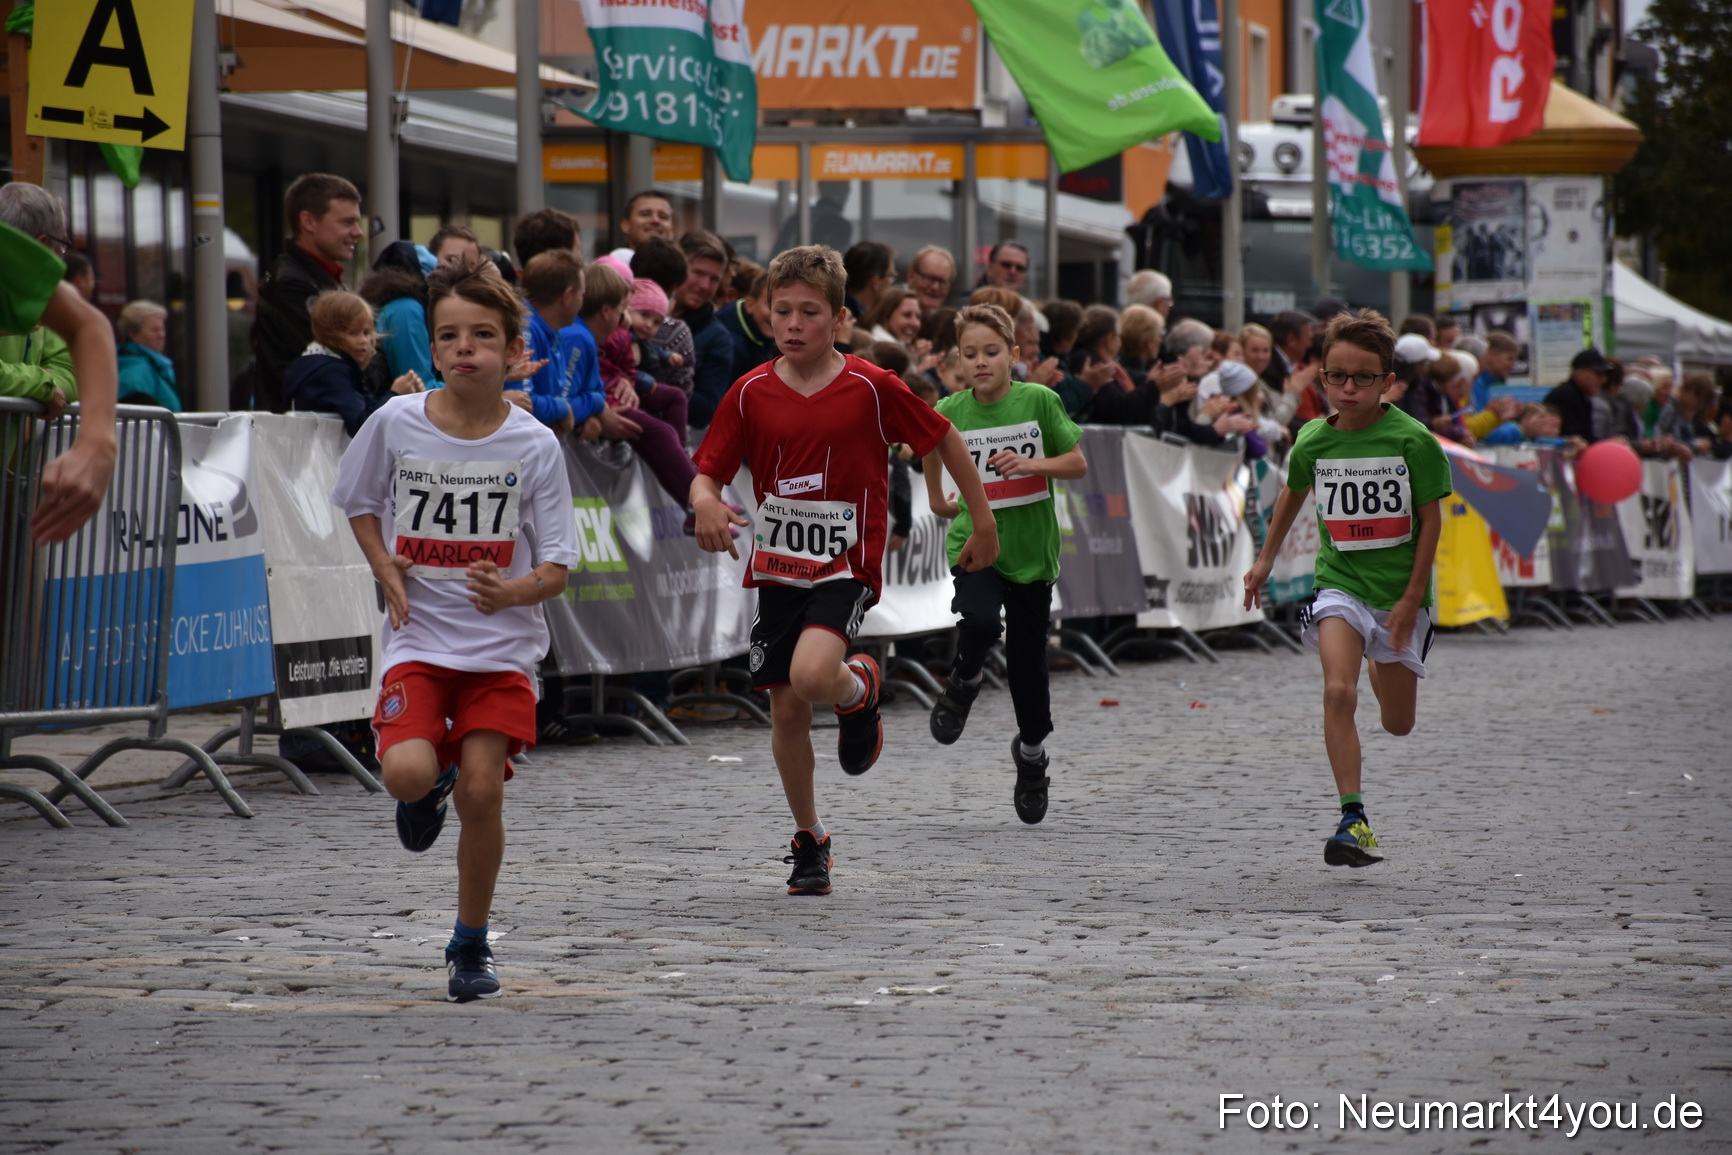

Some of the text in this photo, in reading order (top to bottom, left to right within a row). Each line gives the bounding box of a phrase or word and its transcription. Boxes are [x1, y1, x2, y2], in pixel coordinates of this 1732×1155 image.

[63, 0, 155, 97] A
[823, 152, 952, 174] RUNMARKT.DE
[986, 431, 1027, 445] Neumarkt
[970, 442, 1036, 477] 742
[400, 469, 501, 485] PARTL Neumarkt
[1316, 467, 1392, 478] PARTL Neumarkt
[789, 480, 810, 491] DEHN
[1324, 479, 1403, 516] 7083
[409, 488, 509, 535] 7417
[790, 508, 839, 521] Neumarkt
[765, 516, 848, 559] 7005
[1348, 524, 1374, 538] Tim
[400, 539, 501, 566] MARLON
[213, 604, 269, 651] ZUHAUSE
